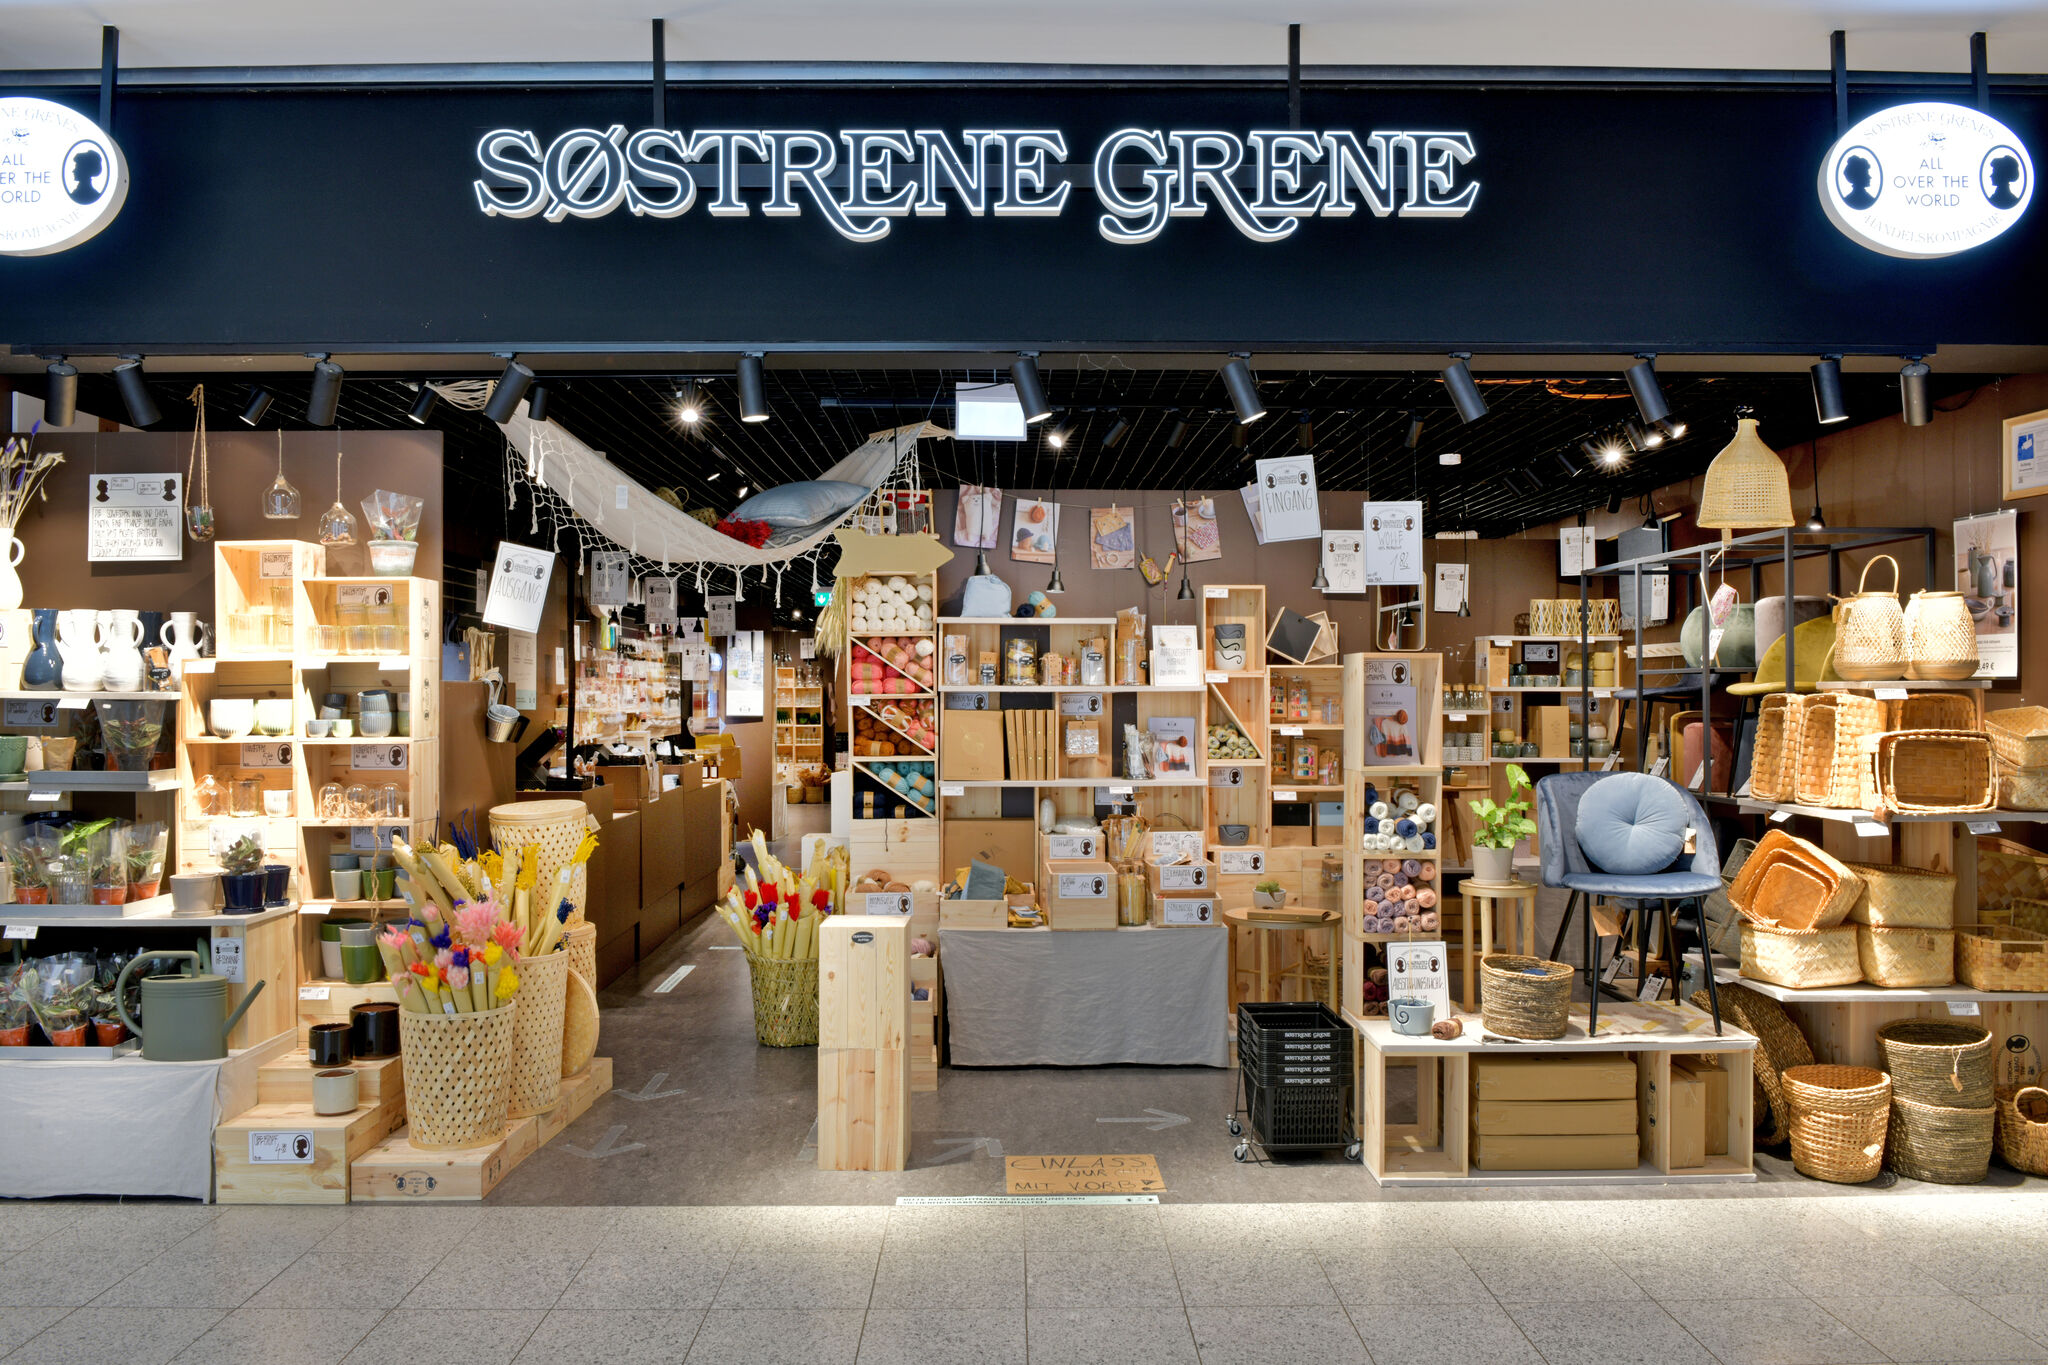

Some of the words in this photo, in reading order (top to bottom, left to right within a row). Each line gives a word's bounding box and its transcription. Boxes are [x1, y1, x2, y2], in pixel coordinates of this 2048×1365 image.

[2, 153, 26, 166] ALL
[1919, 157, 1944, 170] ALL
[0, 171, 16, 185] ER
[24, 171, 52, 184] THE
[473, 124, 1072, 242] SØSTRENE
[1094, 127, 1480, 244] GRENE
[1893, 175, 1934, 189] OVER
[1943, 175, 1969, 188] THE
[1, 190, 41, 204] ORLD
[1905, 193, 1960, 207] WORLD
[1265, 488, 1313, 514] EINGANG
[1377, 530, 1403, 546] WOLLE
[494, 575, 543, 604] AUSGANG
[1065, 1169, 1107, 1178] NUR
[1015, 1182, 1056, 1192] MIT
